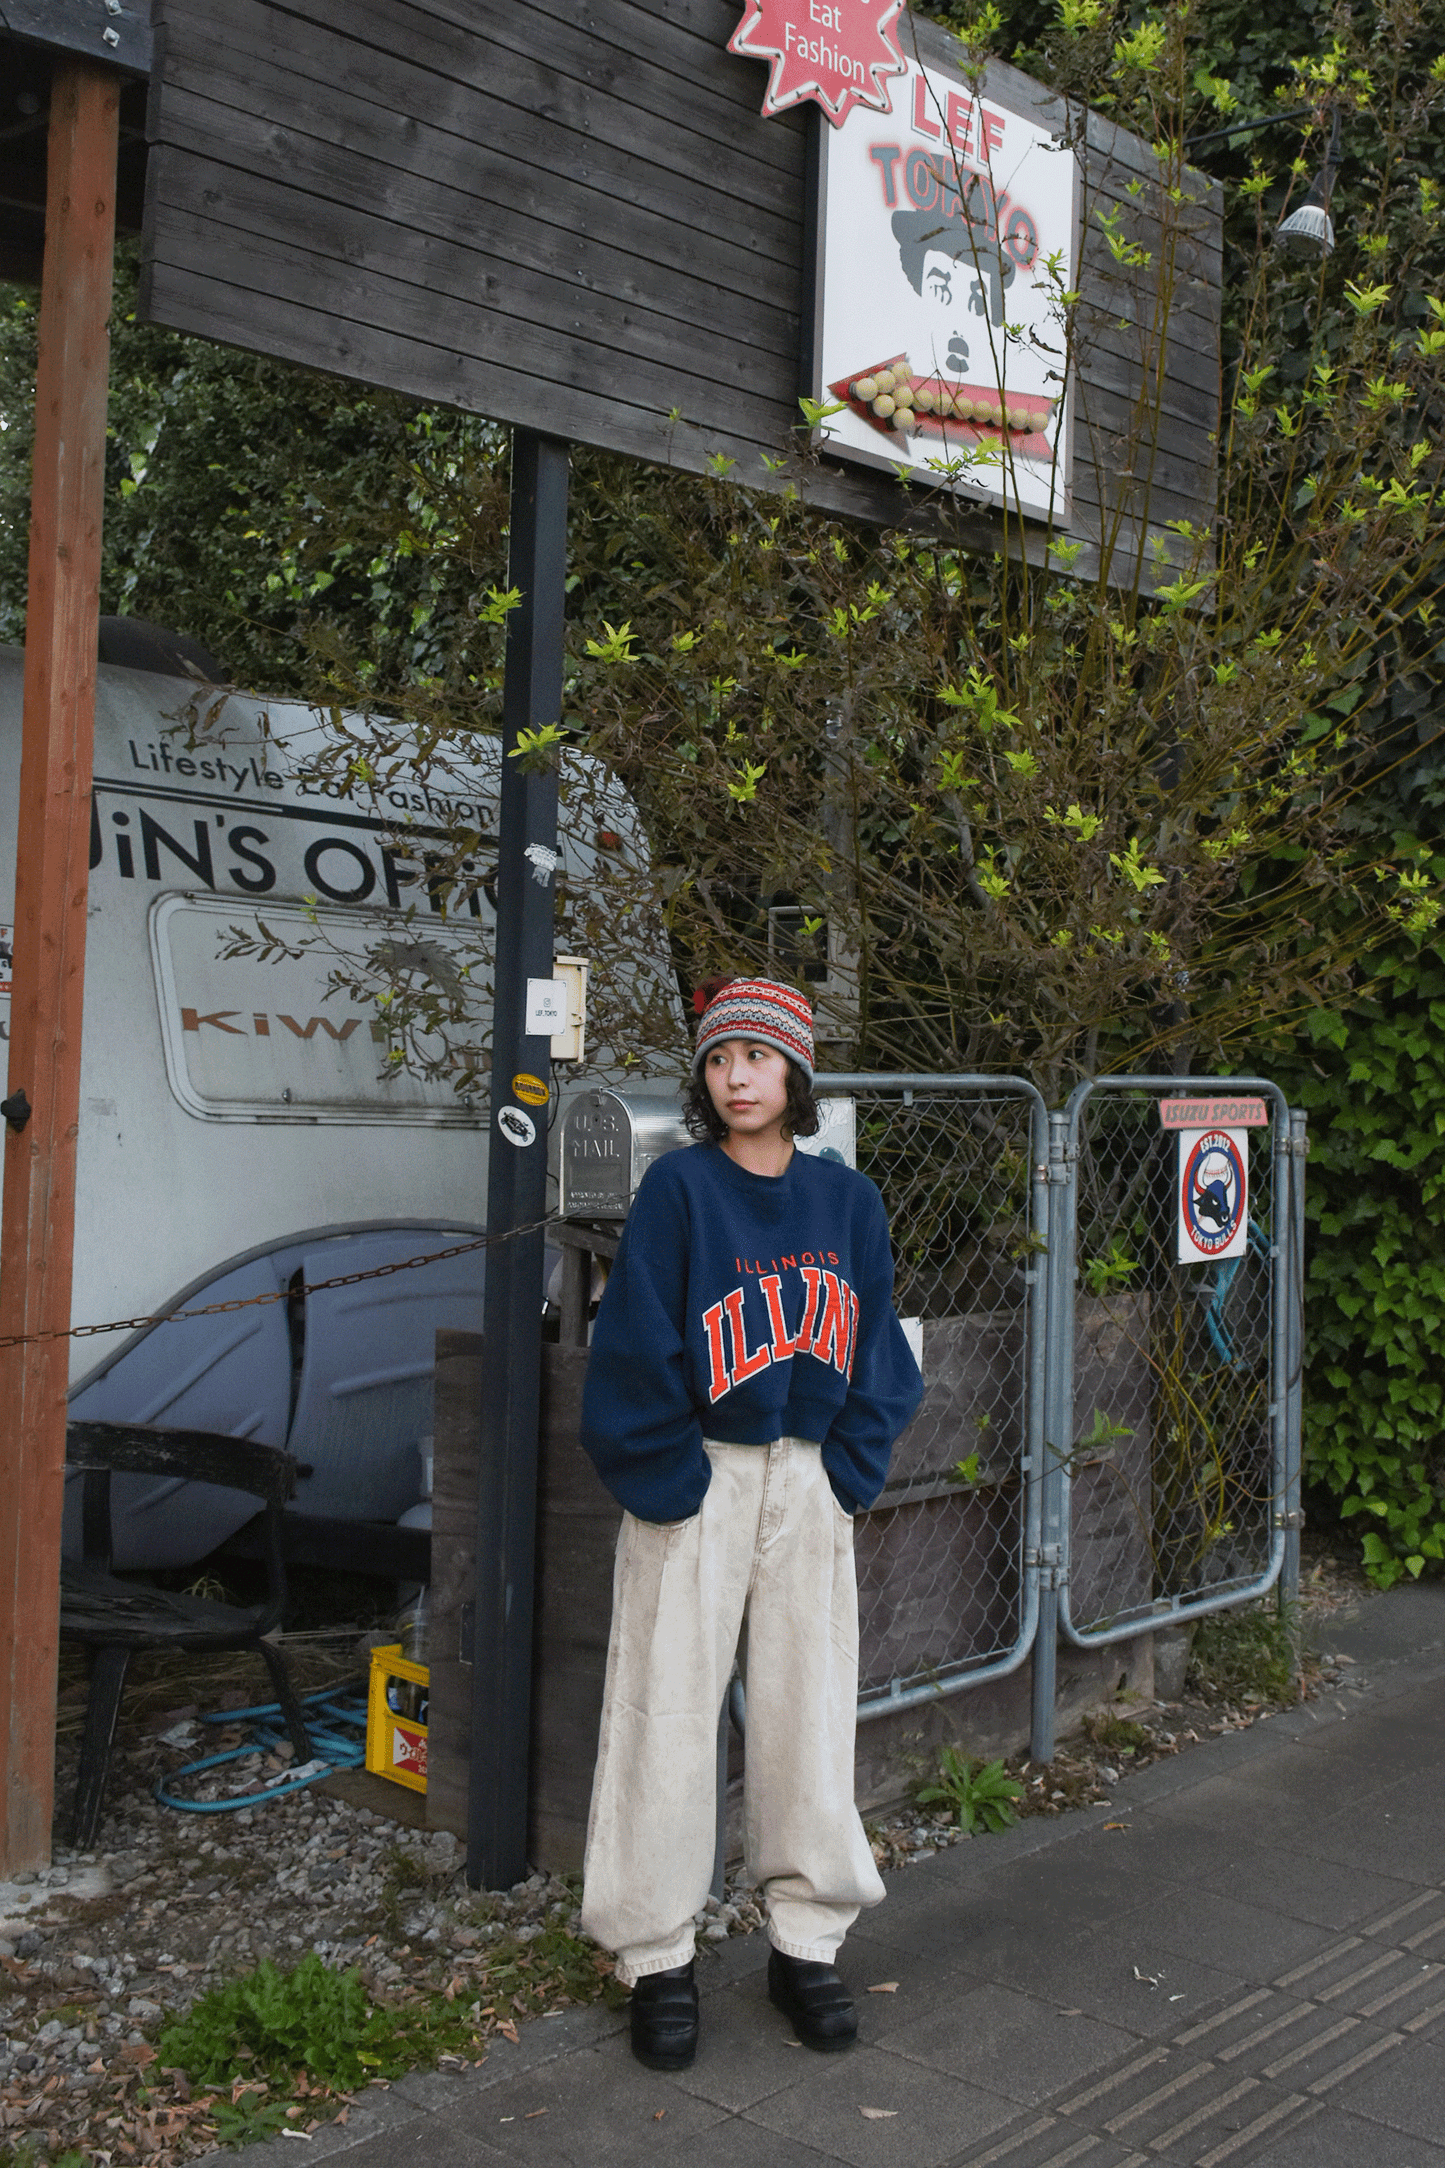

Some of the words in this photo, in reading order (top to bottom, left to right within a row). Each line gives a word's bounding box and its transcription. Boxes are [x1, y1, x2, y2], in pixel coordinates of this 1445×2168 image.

[810, 0, 842, 33] Eat
[785, 21, 865, 84] Fashion
[911, 74, 1005, 166] LEF
[868, 143, 1039, 270] TOKYO
[129, 739, 284, 792] Lifestyle
[1165, 1104, 1209, 1122] ISUZU
[1211, 1102, 1263, 1121] SPORTS
[1190, 1224, 1214, 1251] TOKYO
[1214, 1219, 1237, 1250] BULLS
[735, 1250, 840, 1275] ILLINOIS
